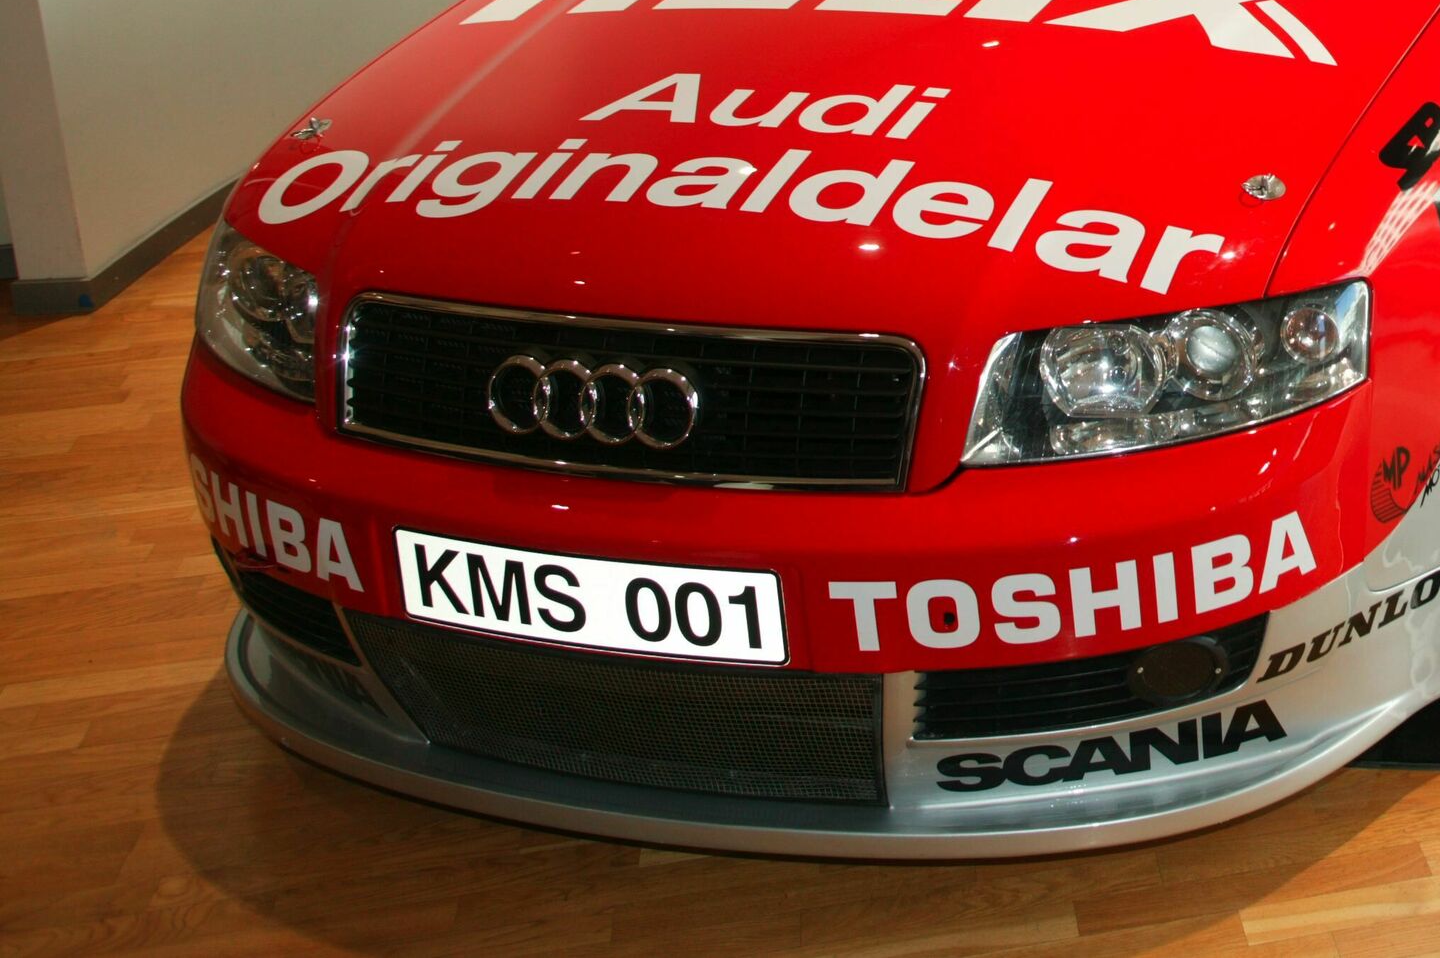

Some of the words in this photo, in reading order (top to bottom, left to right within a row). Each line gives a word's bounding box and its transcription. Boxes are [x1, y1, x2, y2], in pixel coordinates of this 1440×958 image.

[579, 73, 952, 139] Audi
[257, 138, 1226, 296] Originaldelar
[414, 542, 587, 633] KMS
[624, 576, 764, 650] 001
[828, 510, 1317, 652] TOSHIBA
[936, 698, 1288, 793] SCANIA
